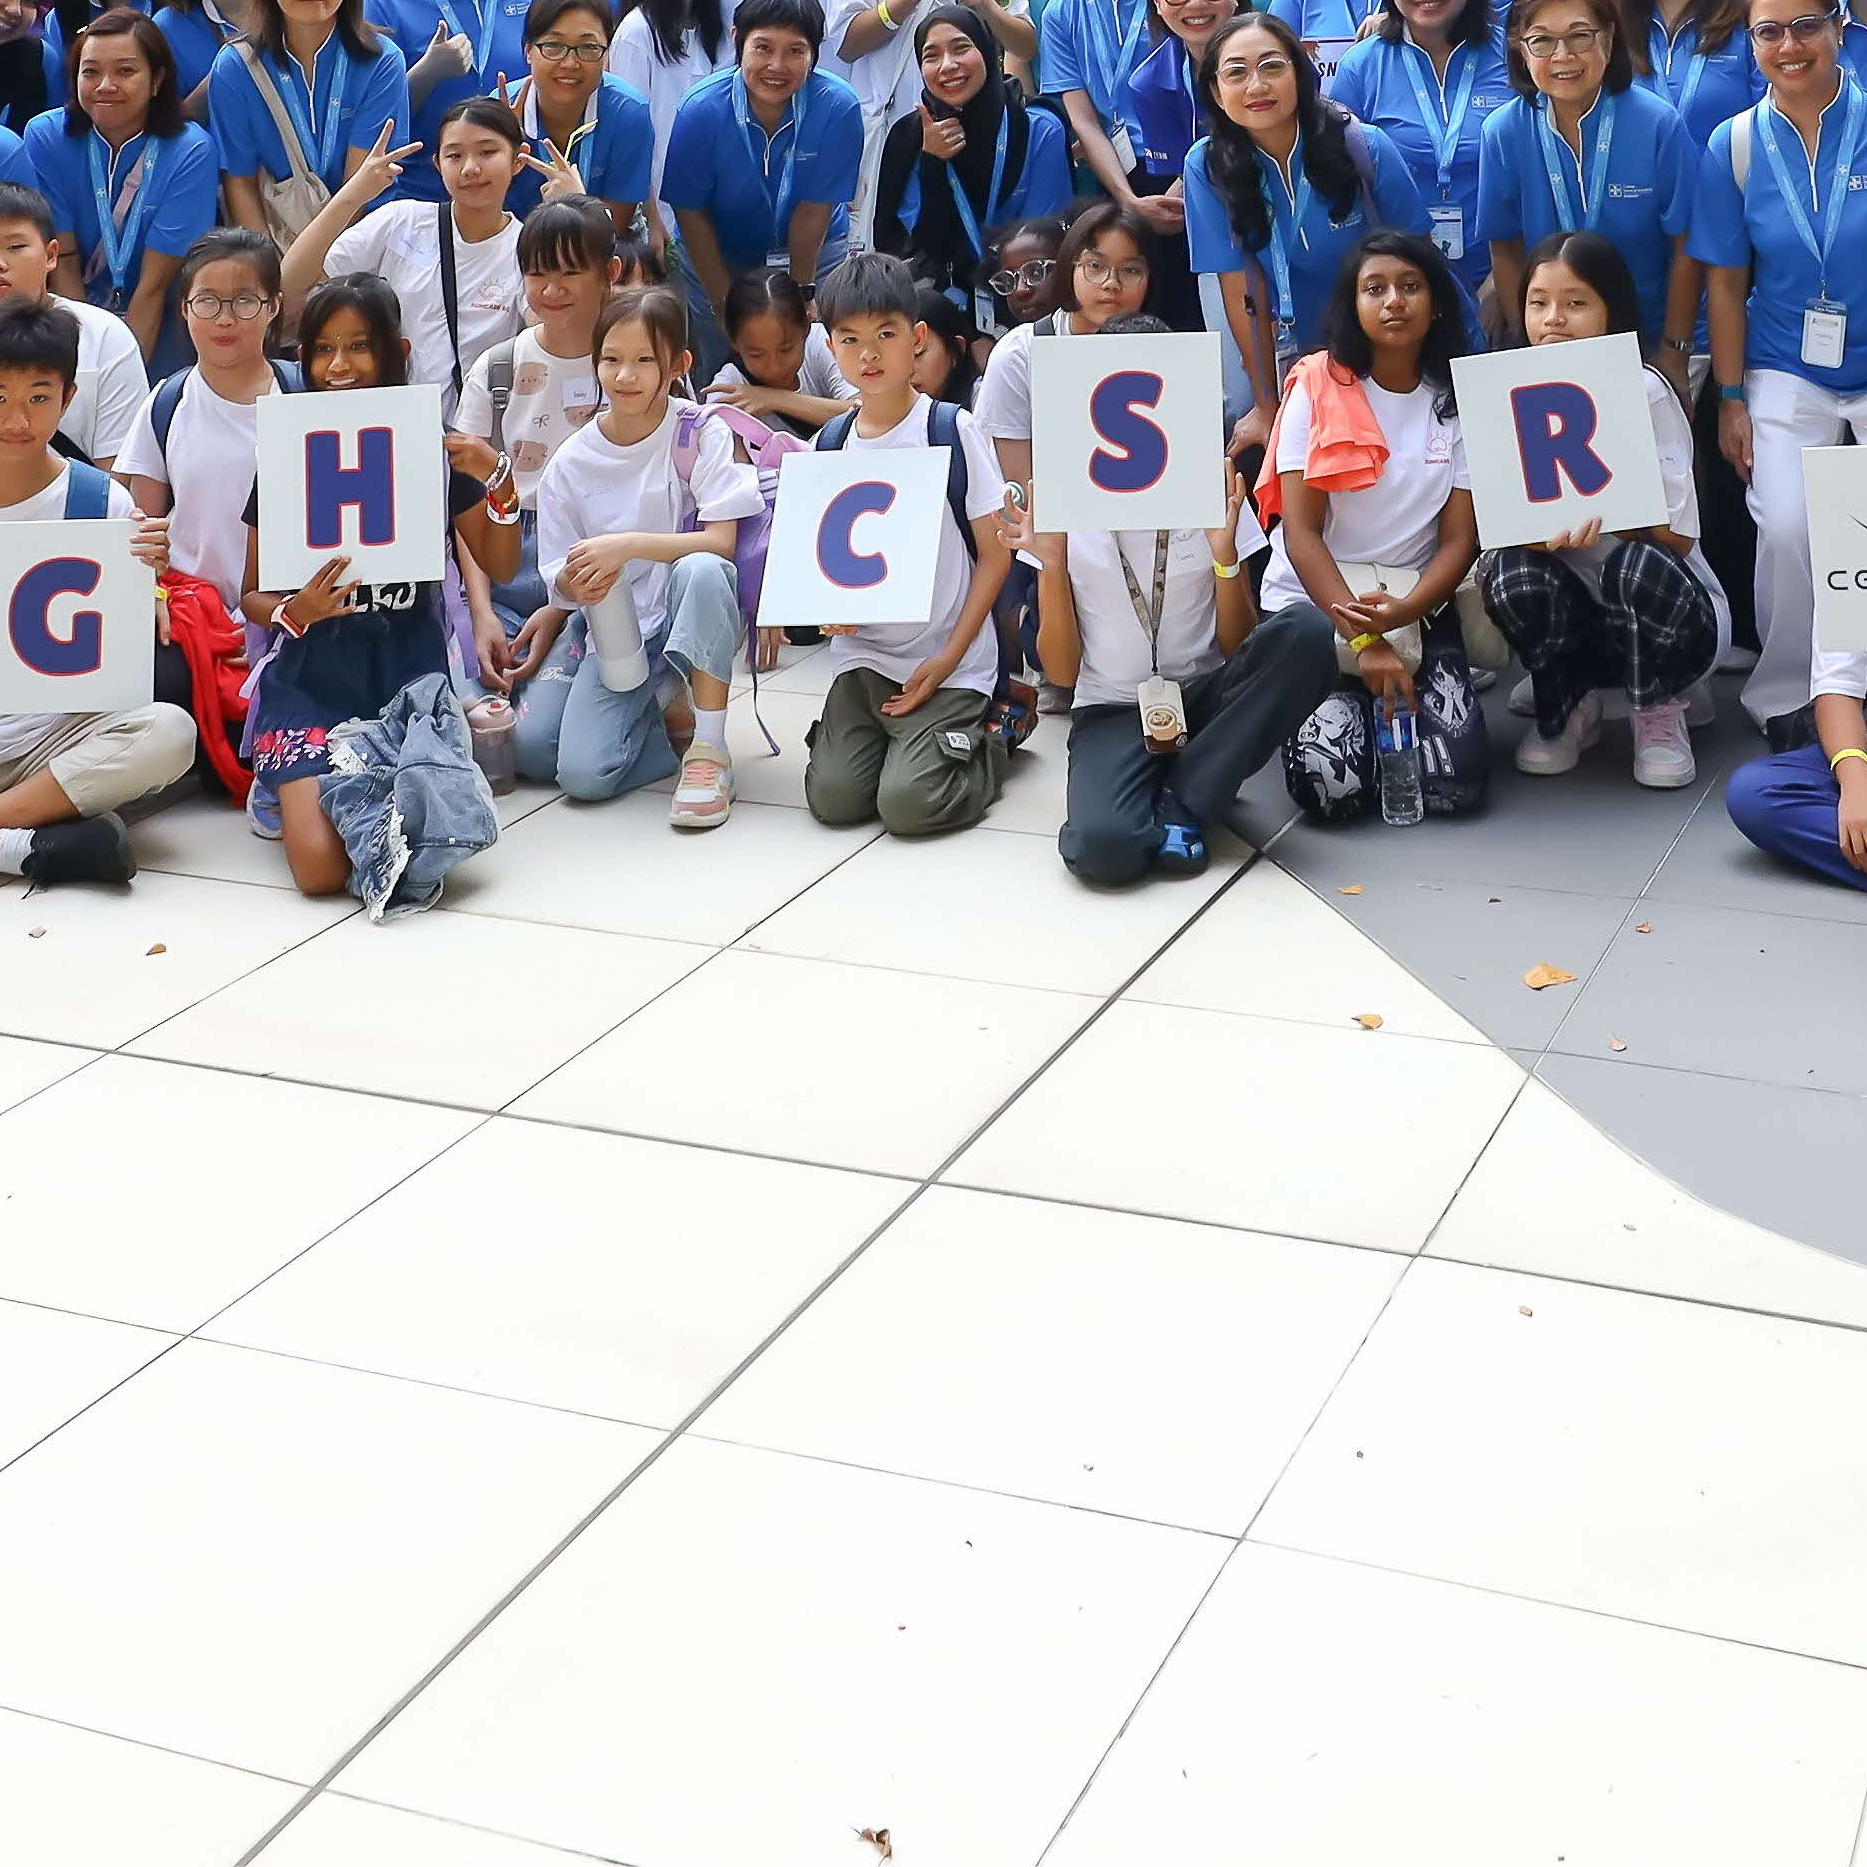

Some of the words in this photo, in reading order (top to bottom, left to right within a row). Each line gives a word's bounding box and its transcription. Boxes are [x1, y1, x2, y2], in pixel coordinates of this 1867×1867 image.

[304, 425, 396, 551] H
[1089, 369, 1170, 495] S
[1509, 380, 1614, 505] R
[816, 479, 898, 591] C
[8, 555, 103, 677] G
